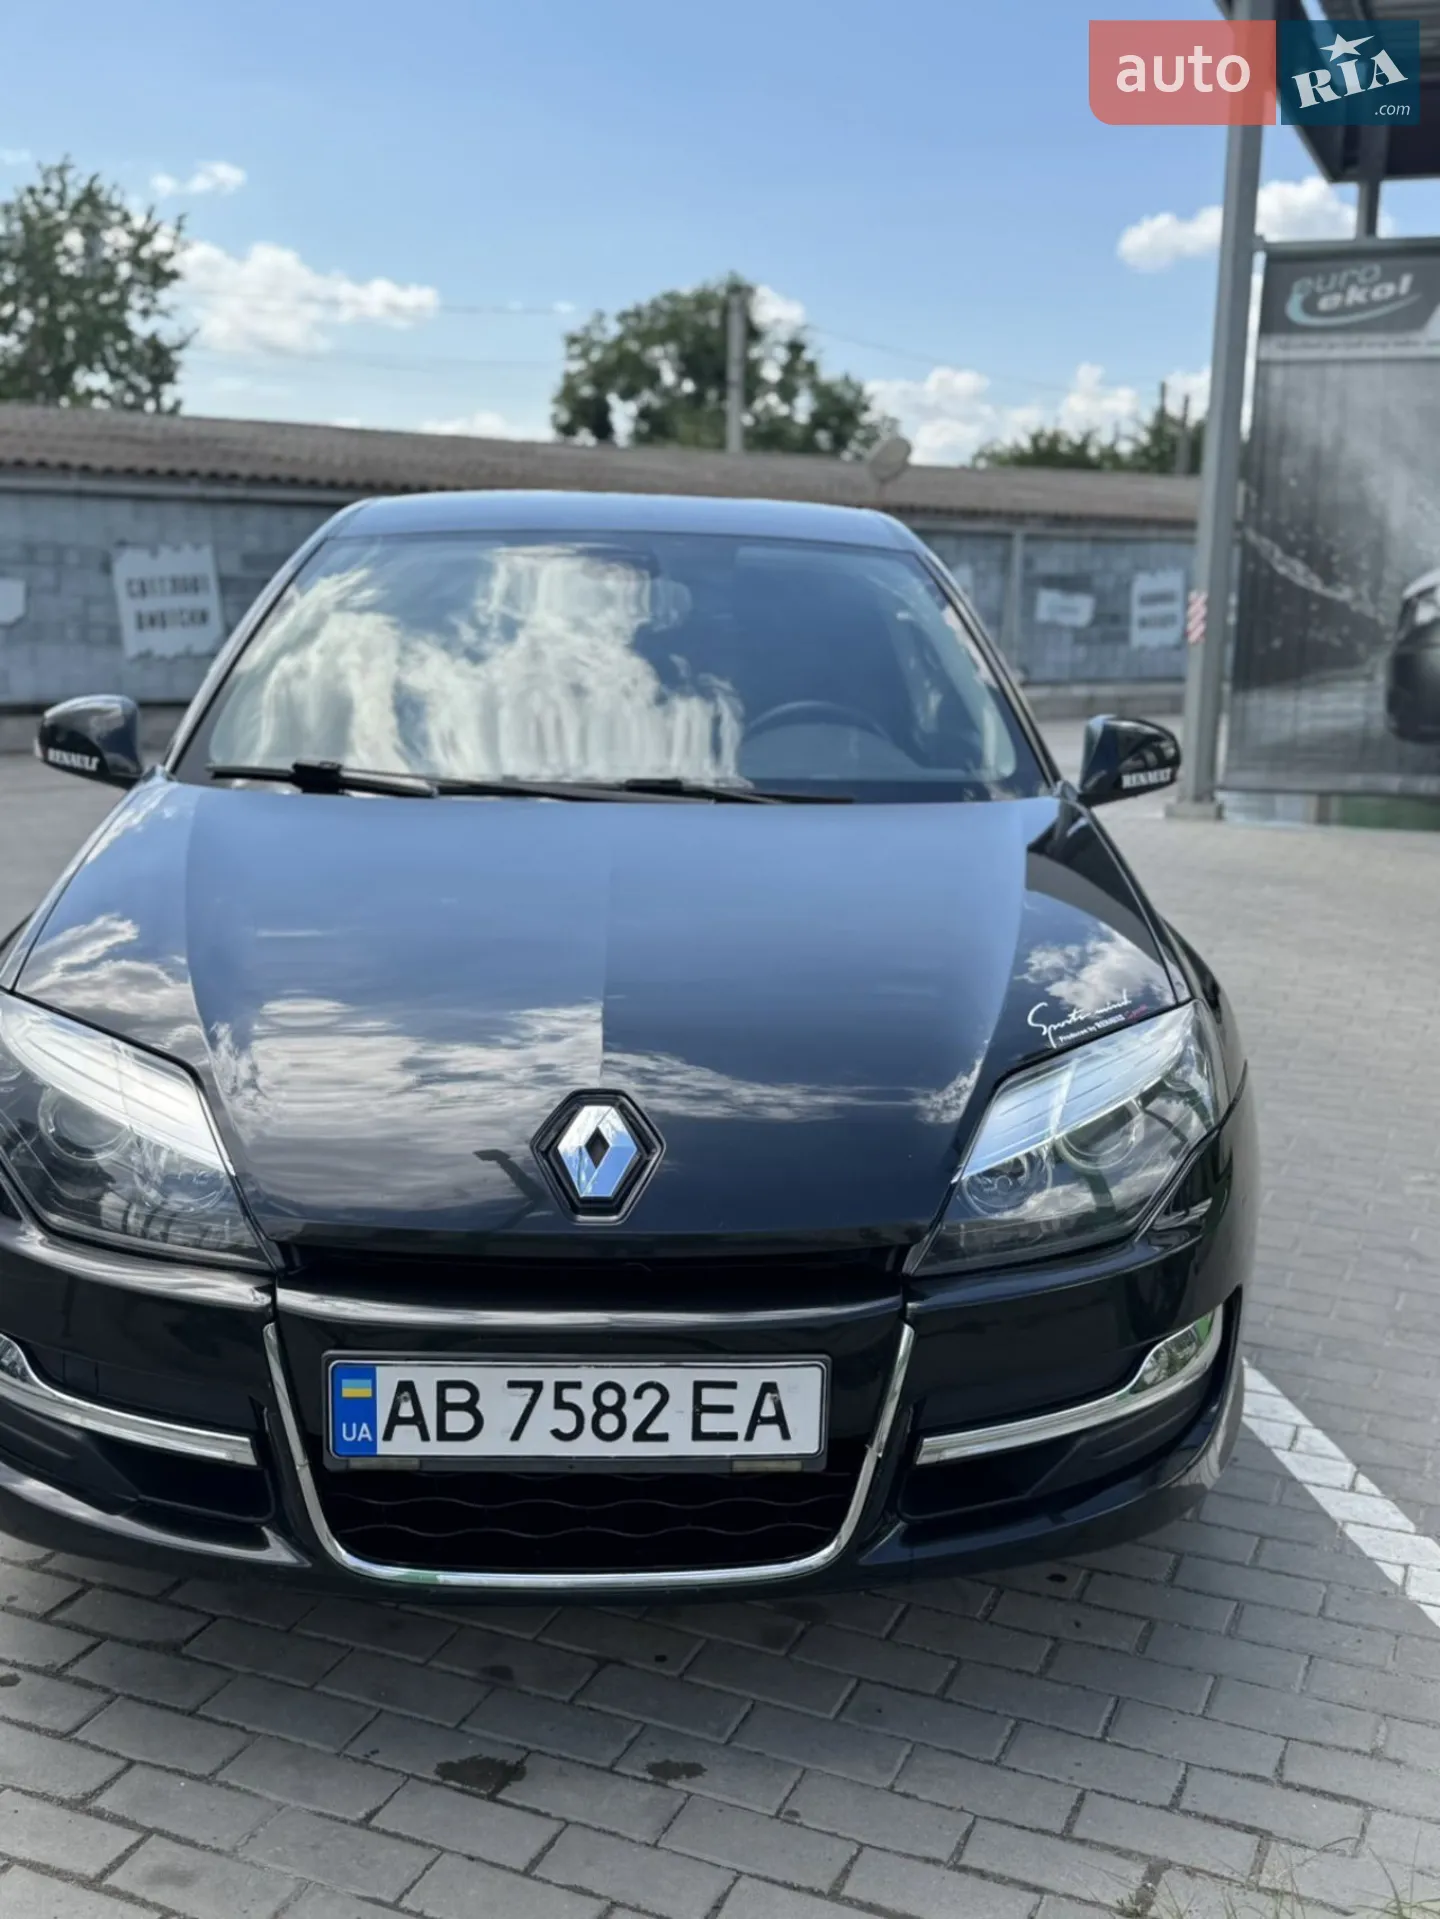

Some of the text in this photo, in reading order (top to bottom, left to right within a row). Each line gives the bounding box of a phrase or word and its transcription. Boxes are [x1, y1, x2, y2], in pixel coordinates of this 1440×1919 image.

[382, 1380, 792, 1442] AB 7582 EA
[341, 1422, 373, 1442] UA
